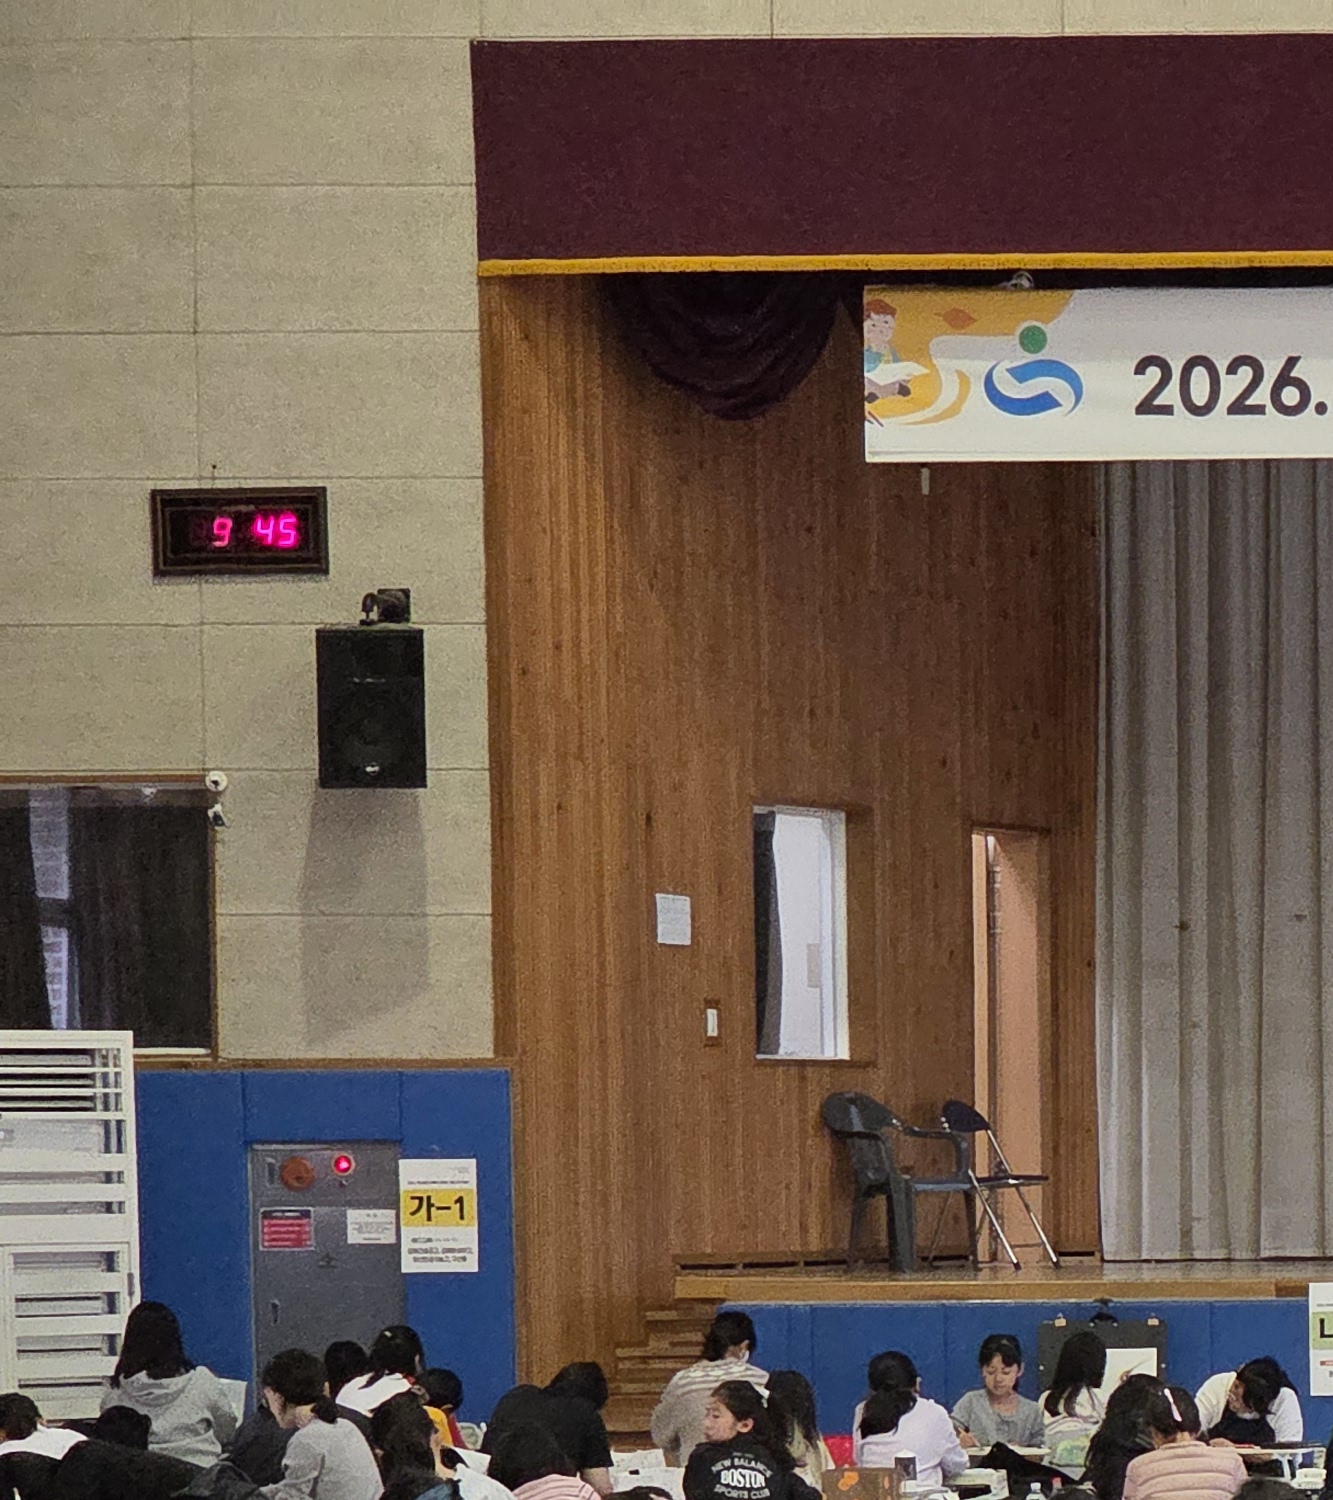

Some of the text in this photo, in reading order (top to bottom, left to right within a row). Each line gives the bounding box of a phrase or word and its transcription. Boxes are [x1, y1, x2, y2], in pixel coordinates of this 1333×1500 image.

[1133, 354, 1328, 417] 2026.
[254, 513, 298, 548] 45
[409, 1195, 465, 1222] 가-1
[721, 1468, 766, 1488] BOSTON
